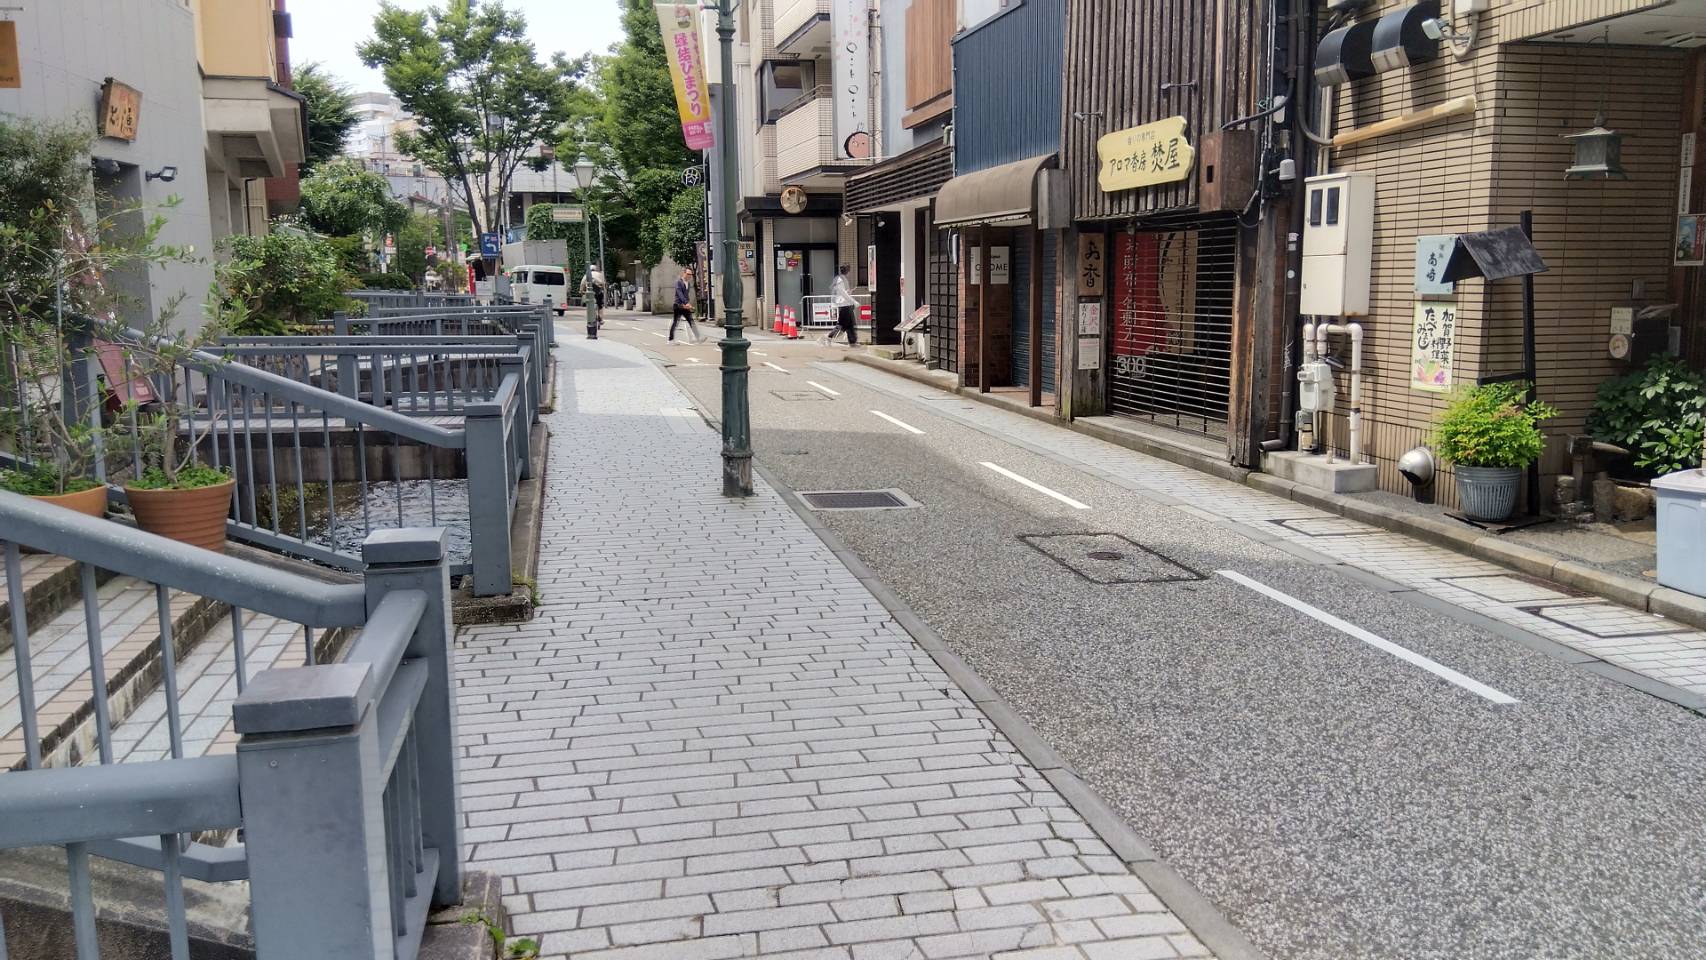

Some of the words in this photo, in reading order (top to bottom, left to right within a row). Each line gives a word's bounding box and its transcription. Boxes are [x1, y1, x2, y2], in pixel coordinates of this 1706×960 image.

[674, 32, 702, 116] 縁結びまつり
[1082, 240, 1101, 288] お香
